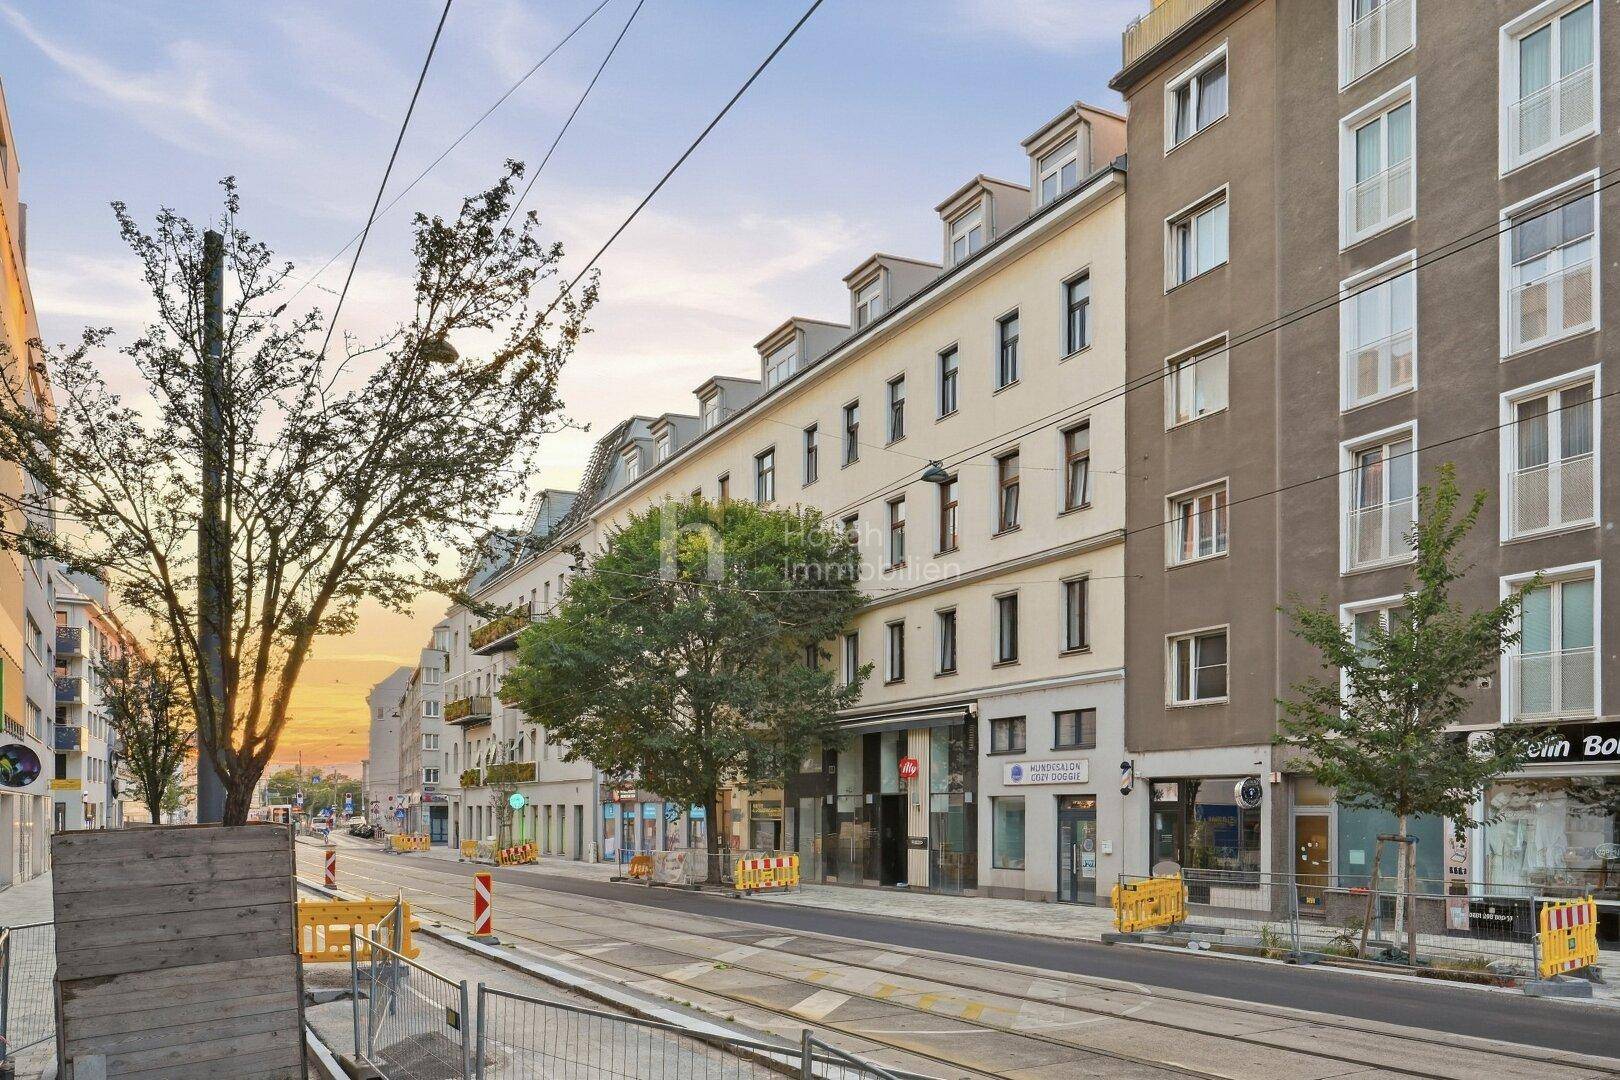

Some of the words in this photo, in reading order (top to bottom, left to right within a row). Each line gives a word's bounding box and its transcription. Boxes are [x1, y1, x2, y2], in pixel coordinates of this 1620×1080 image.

[902, 761, 916, 775] illy
[1031, 763, 1080, 772] HUNDESALON
[1031, 773, 1048, 781] COZY
[1052, 773, 1080, 781] DOGGIE
